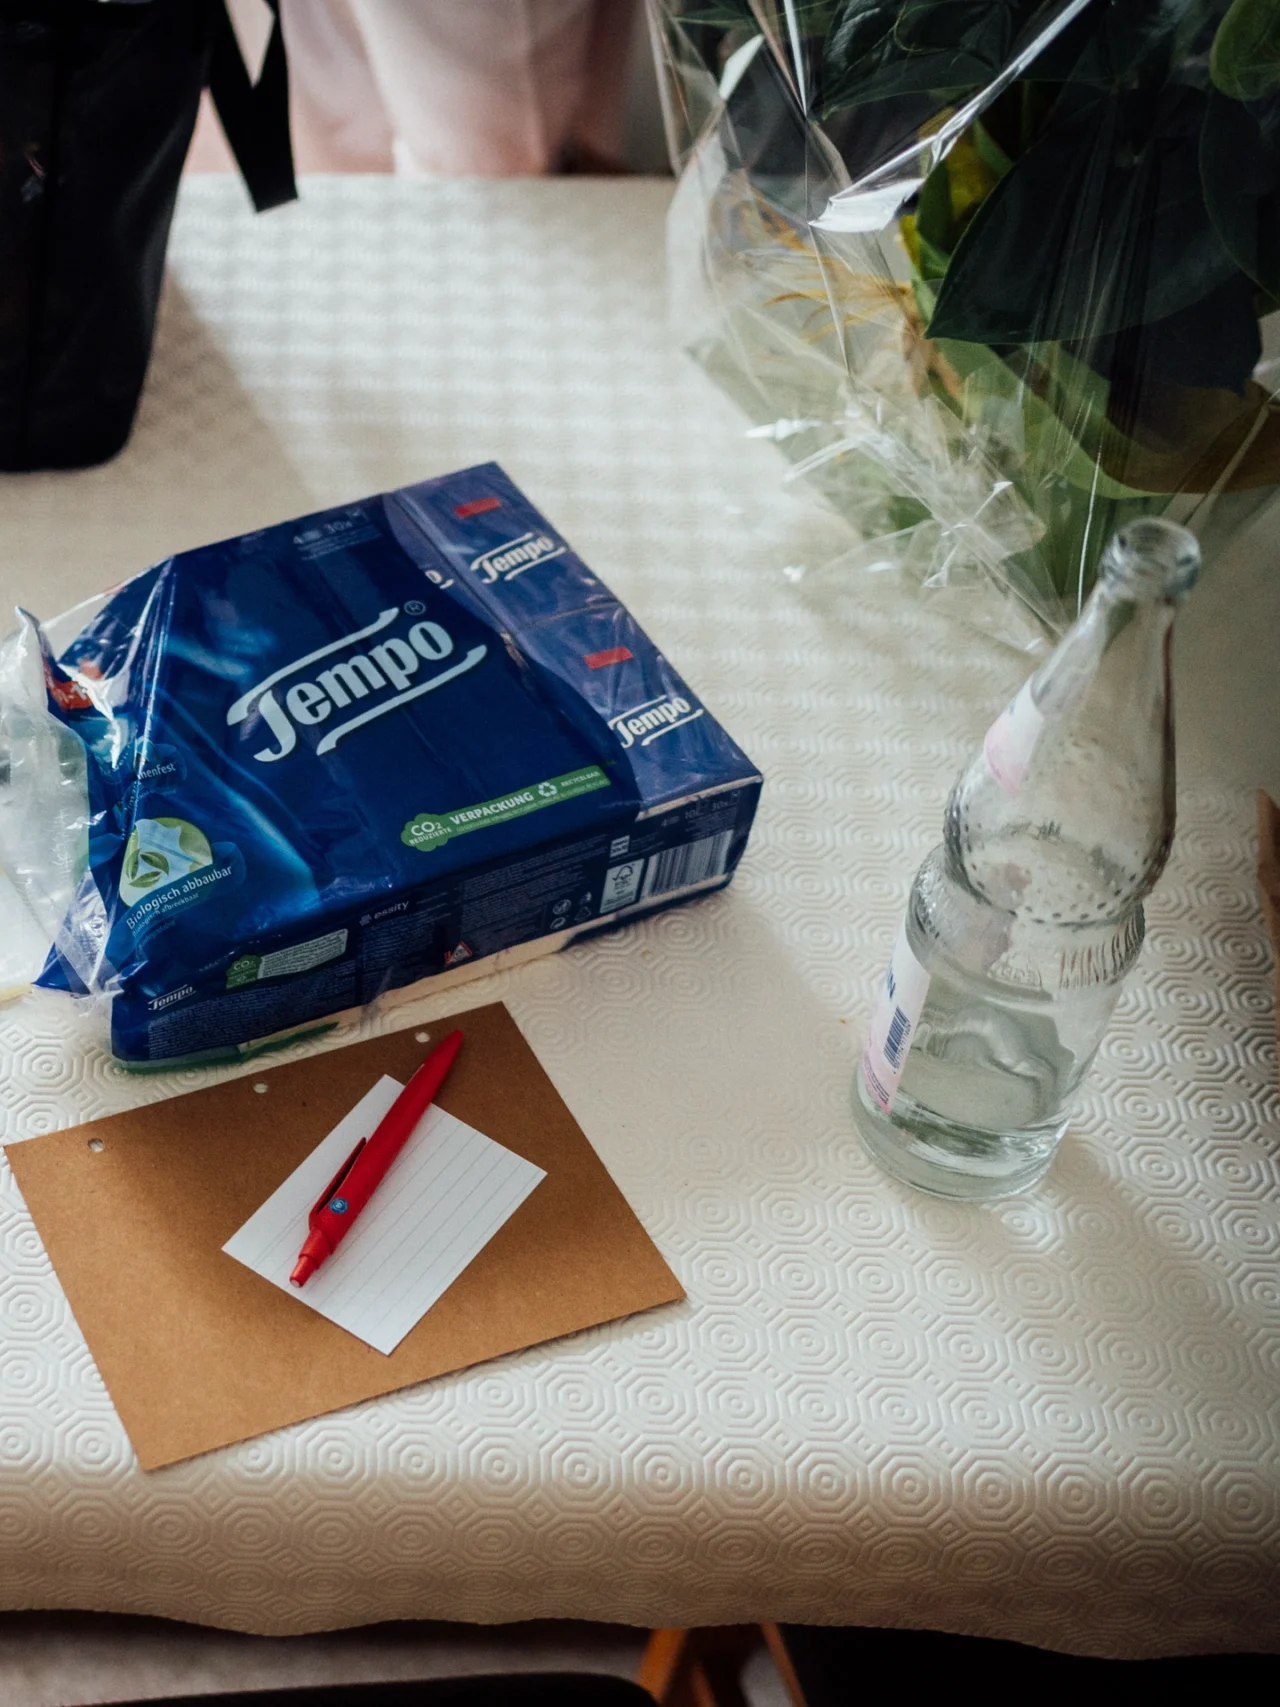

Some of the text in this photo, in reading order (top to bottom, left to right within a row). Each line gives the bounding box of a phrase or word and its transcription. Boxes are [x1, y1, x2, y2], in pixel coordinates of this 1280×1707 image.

[470, 532, 568, 584] Tempo
[226, 607, 488, 762] Tempo
[608, 694, 704, 748] Tempo
[450, 792, 534, 825] VERPACKUNG
[409, 827, 452, 846] REDUZIERTE
[126, 865, 233, 930] Biologisch abbaubar
[373, 900, 410, 921] essity
[148, 983, 197, 1011] Tempo
